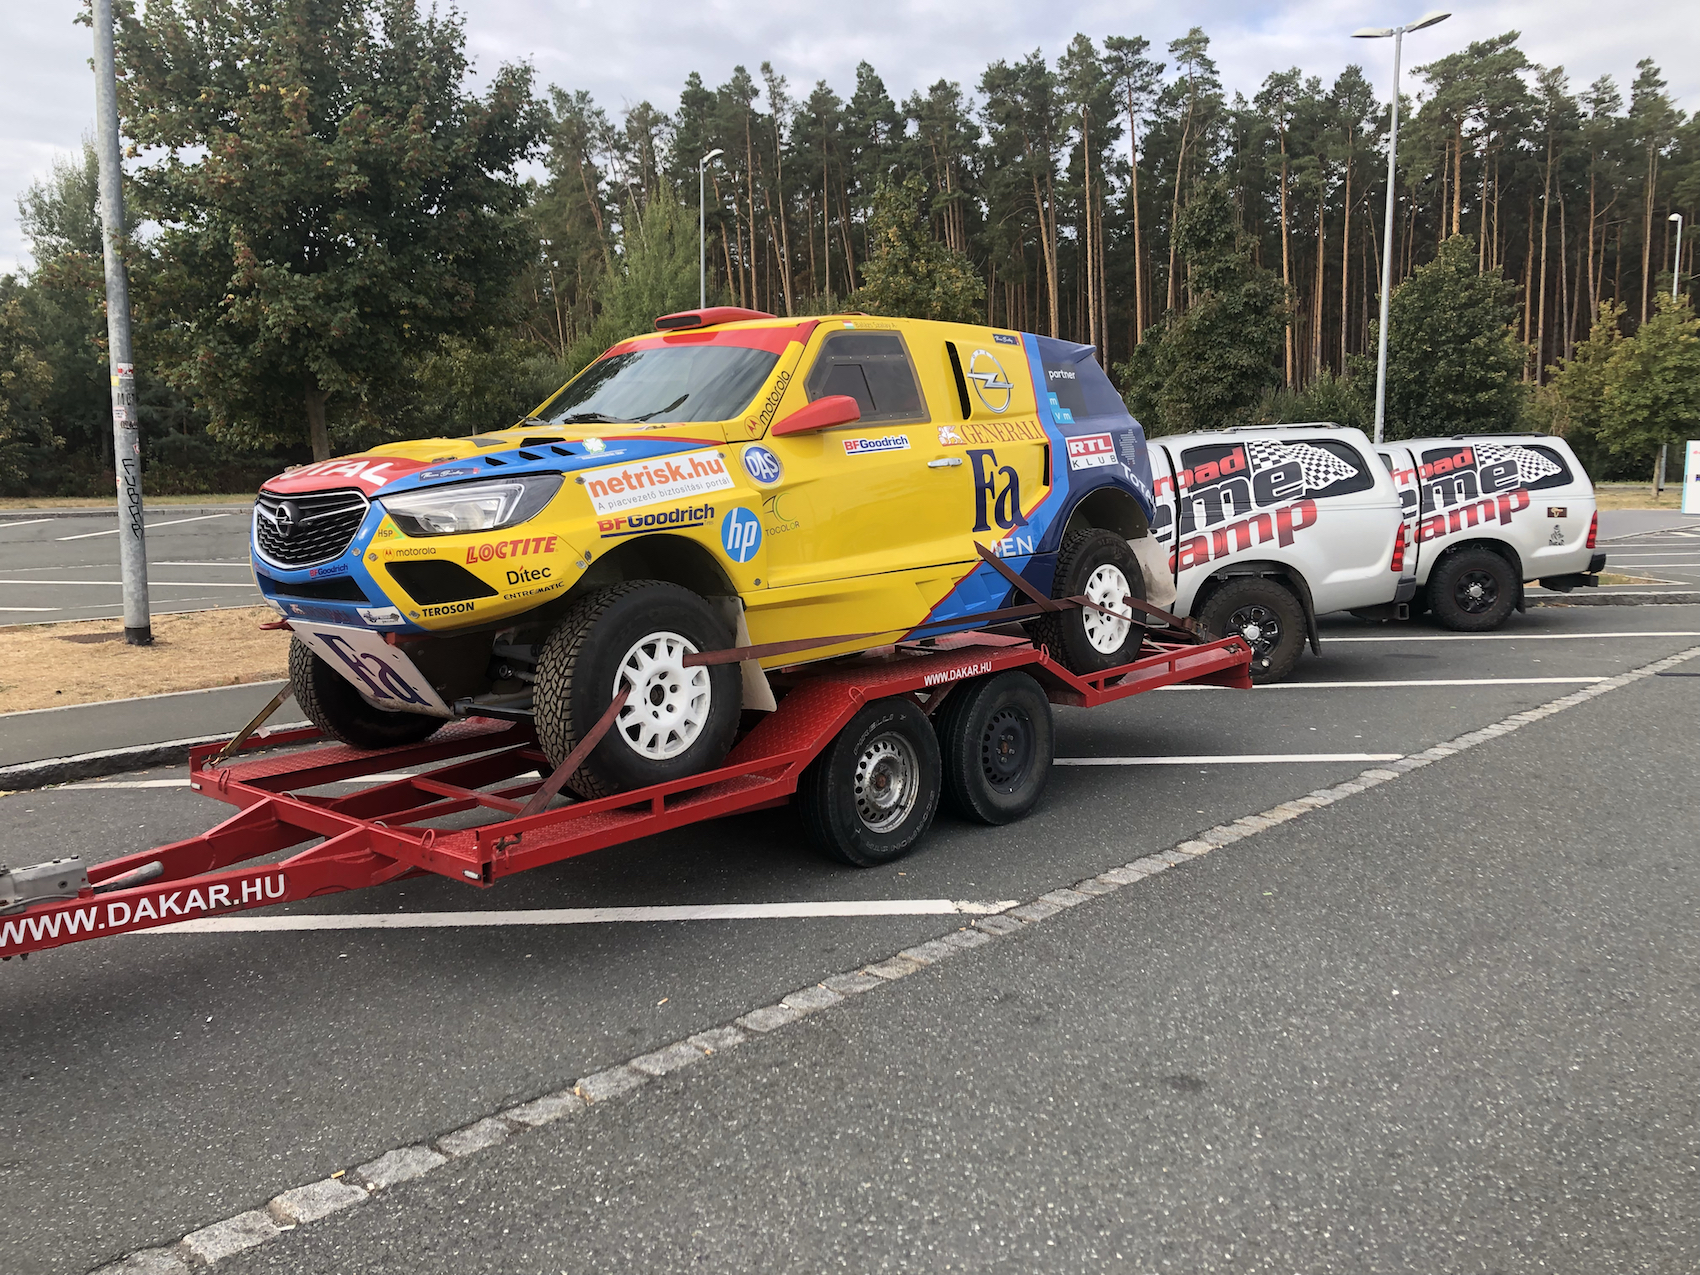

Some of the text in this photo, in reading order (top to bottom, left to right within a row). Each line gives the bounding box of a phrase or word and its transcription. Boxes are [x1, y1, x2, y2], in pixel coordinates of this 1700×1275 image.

[1048, 370, 1075, 380] partner
[760, 371, 790, 426] motorola
[844, 436, 908, 451] BFGoodrich
[960, 421, 1045, 445] GENERALI
[1069, 438, 1112, 455] RTL
[745, 451, 779, 479] DAS
[1072, 455, 1116, 469] KLUB
[1154, 446, 1246, 497] road
[588, 458, 725, 498] netrisk.hu
[966, 449, 1029, 532] Fa
[598, 502, 606, 511] A
[706, 476, 730, 489] portál
[597, 504, 715, 532] BFGoodrich
[1405, 488, 1530, 548] amp
[727, 508, 758, 562] hp
[1169, 499, 1317, 574] amp
[396, 546, 436, 557] motorola
[466, 536, 557, 564] LOCTITE
[310, 563, 348, 578] BFGoodrich
[422, 602, 474, 618] TEROSON
[313, 632, 433, 707] Fa
[924, 661, 992, 686] WWW.DAKAR.HU
[0, 874, 285, 947] WWW.DAKAR.HU
